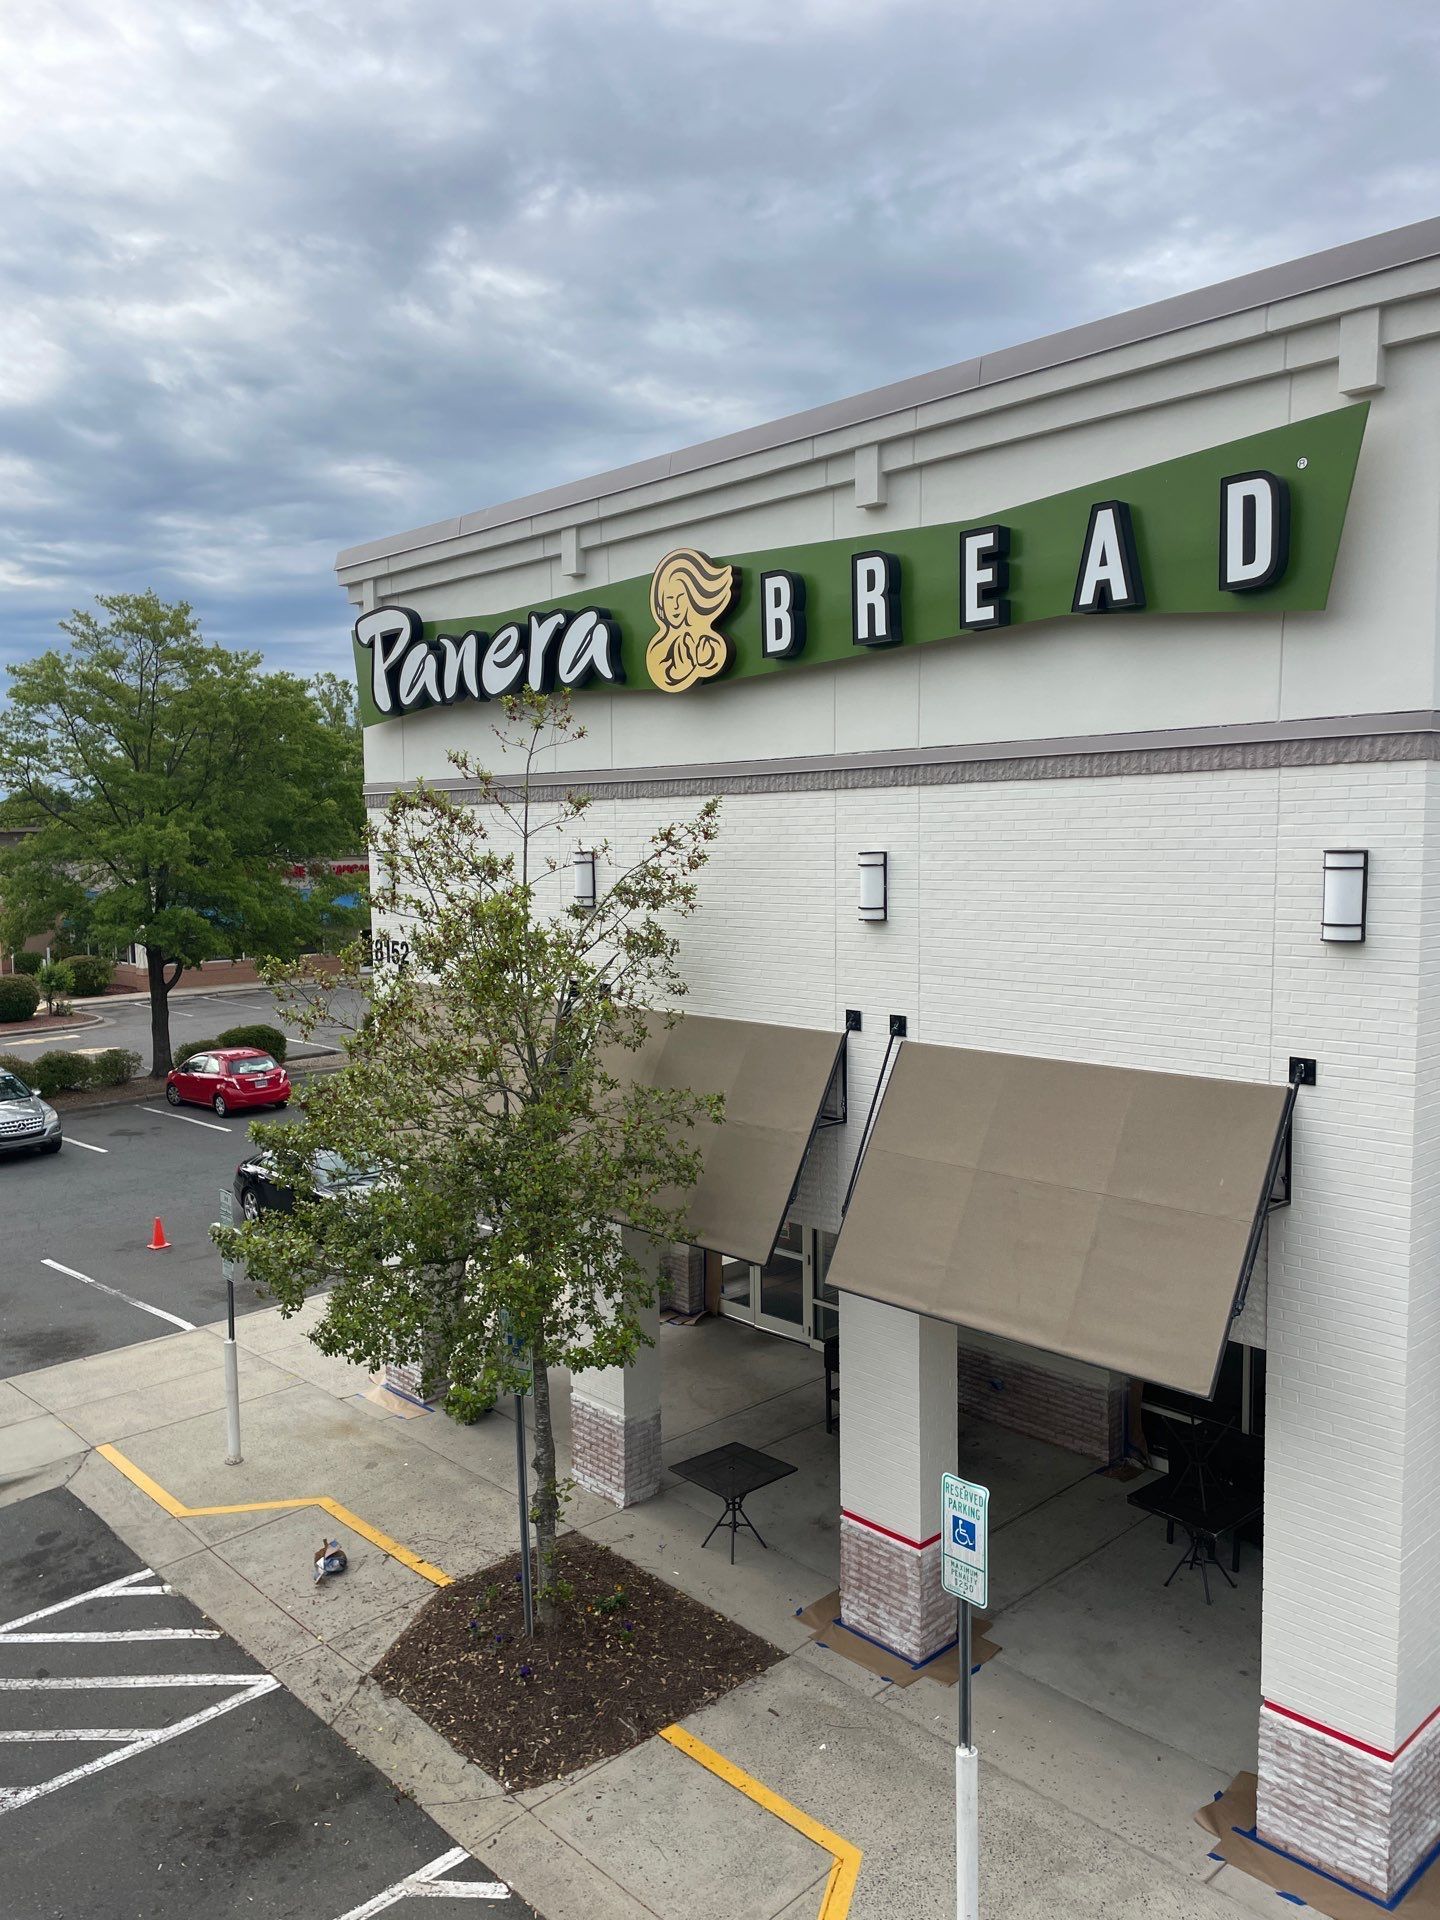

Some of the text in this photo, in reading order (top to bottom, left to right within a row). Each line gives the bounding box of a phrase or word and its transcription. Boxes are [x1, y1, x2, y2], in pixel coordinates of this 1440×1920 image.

[355, 605, 620, 714] Panera
[762, 471, 1286, 660] BREAD
[375, 938, 410, 965] 8152
[945, 1481, 984, 1508] RESERVED
[948, 1497, 981, 1521] PARKING
[950, 1560, 979, 1578] MAXIMUM
[951, 1568, 978, 1585] PENALTY
[954, 1577, 974, 1593] $250
